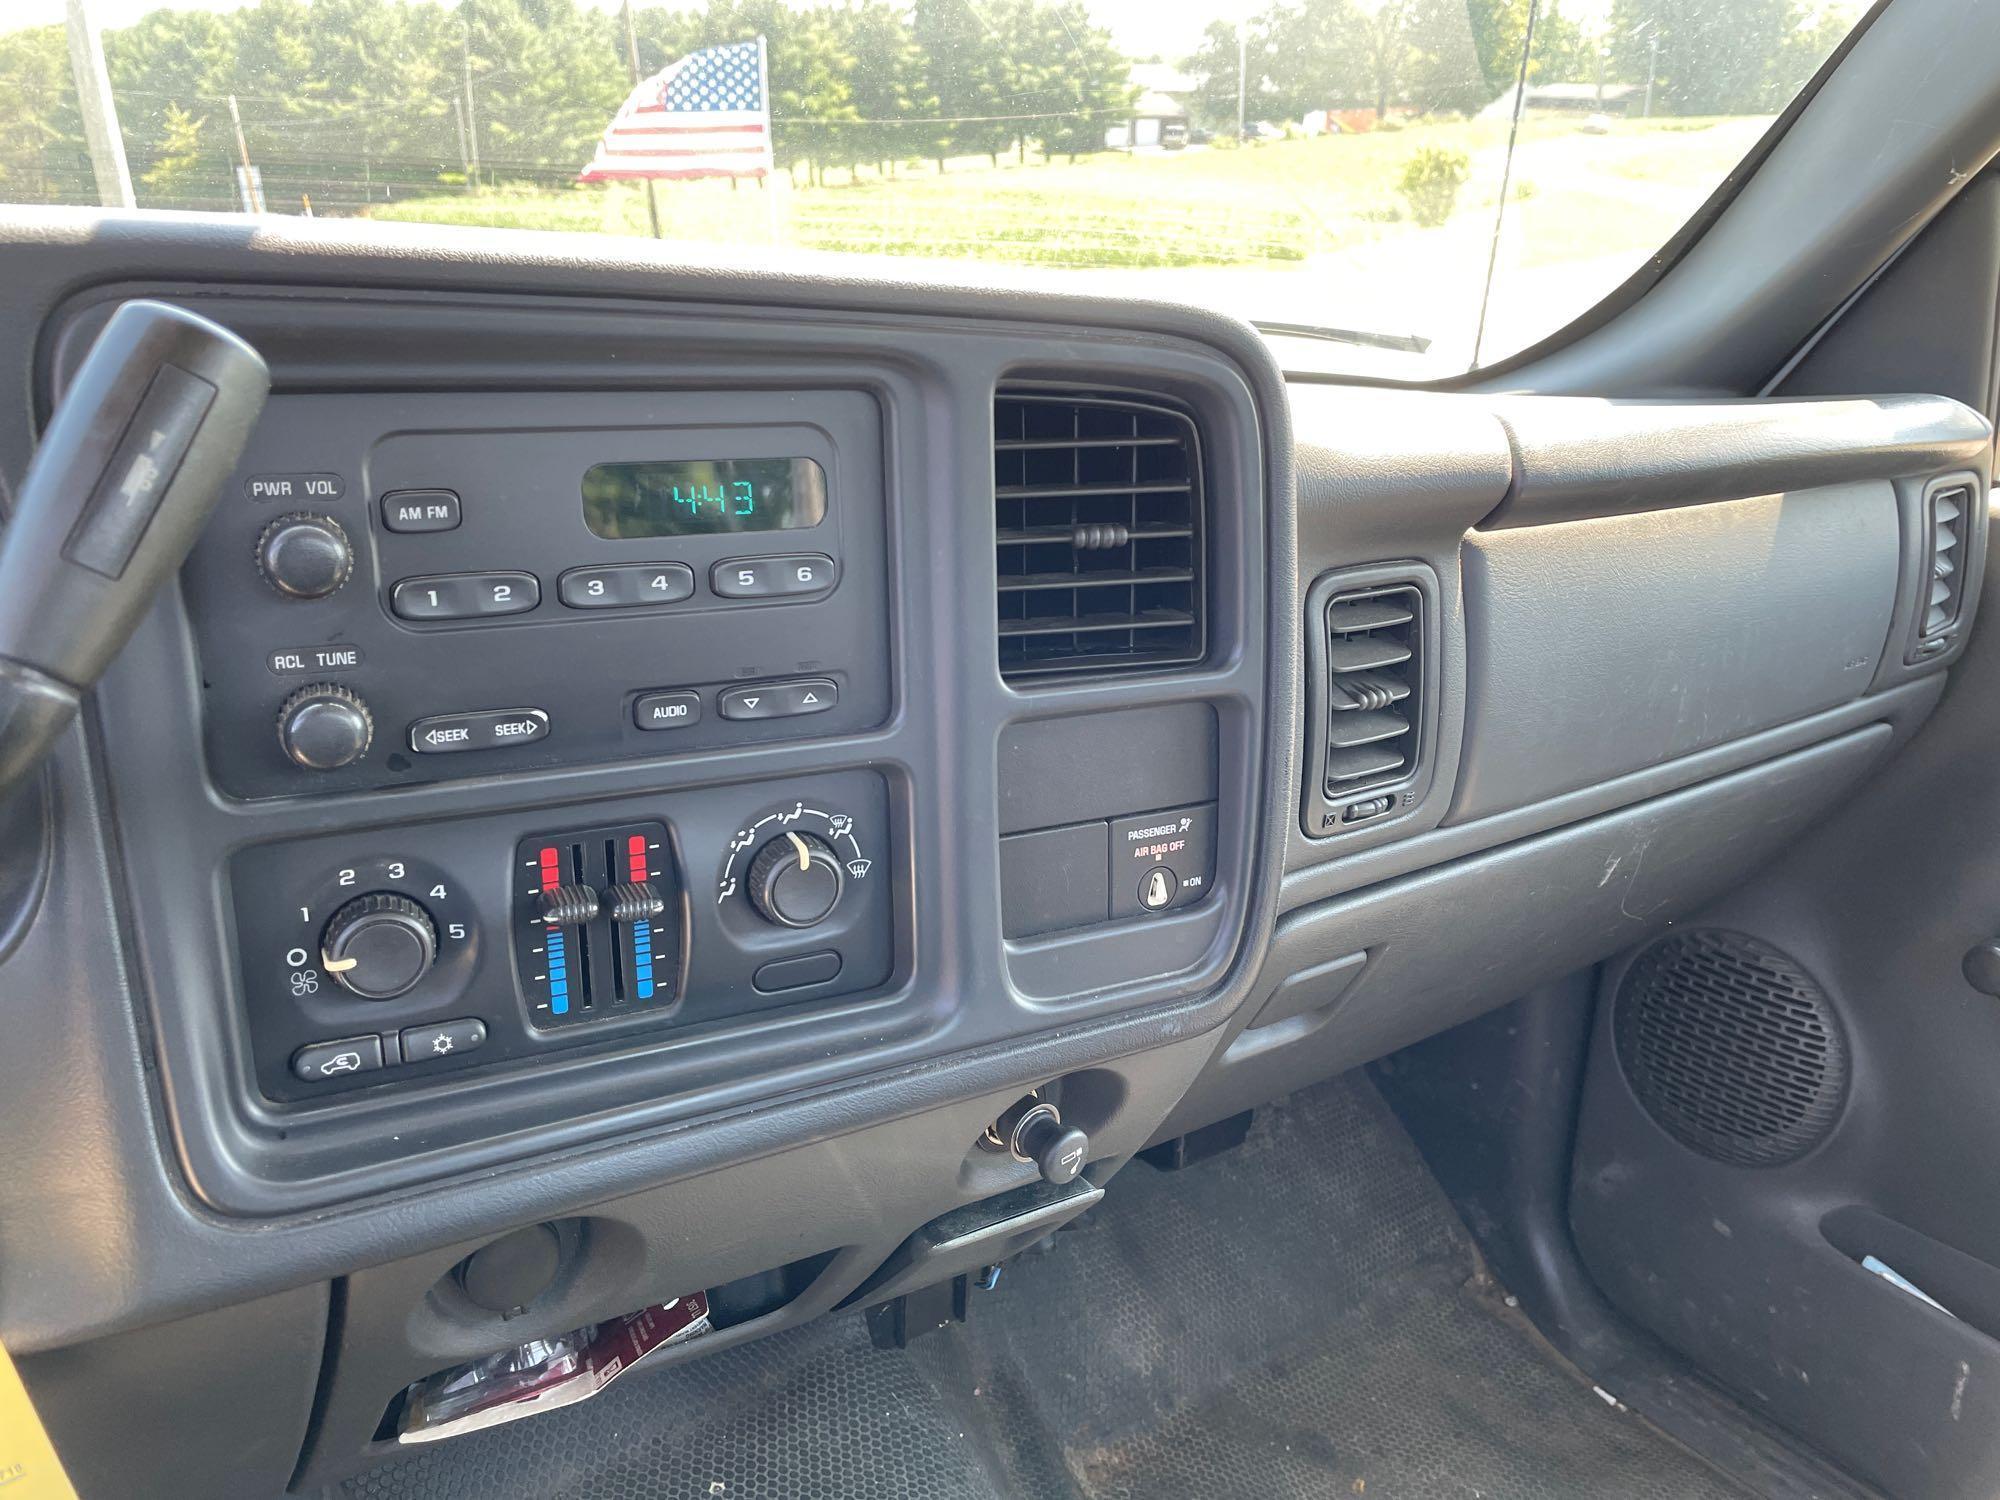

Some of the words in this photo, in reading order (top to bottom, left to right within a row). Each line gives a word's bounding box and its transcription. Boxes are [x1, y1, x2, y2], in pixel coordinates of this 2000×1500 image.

[253, 481, 292, 497] PWR
[305, 480, 337, 495] VOL
[673, 481, 753, 515] 4:43
[399, 507, 422, 521] AM
[427, 505, 448, 519] FM
[738, 570, 754, 586] 5
[797, 566, 813, 582] 6
[587, 580, 605, 596] 3
[651, 575, 669, 591] 4
[427, 590, 438, 607] 1
[493, 585, 511, 602] 2
[275, 655, 304, 670] RCL
[316, 651, 357, 667] TUNE
[653, 704, 687, 719] AUDIO
[437, 728, 469, 743] SEEK
[495, 722, 527, 736] SEEK
[1128, 824, 1176, 840] PASSENGER
[1134, 846, 1148, 858] AIR
[1150, 843, 1167, 855] BAG
[1169, 840, 1185, 852] OFF
[338, 869, 355, 886] 2
[388, 863, 405, 879] 3
[1190, 876, 1201, 887] ON
[429, 884, 447, 899] 4
[300, 907, 310, 922] 1
[448, 924, 465, 939] 5
